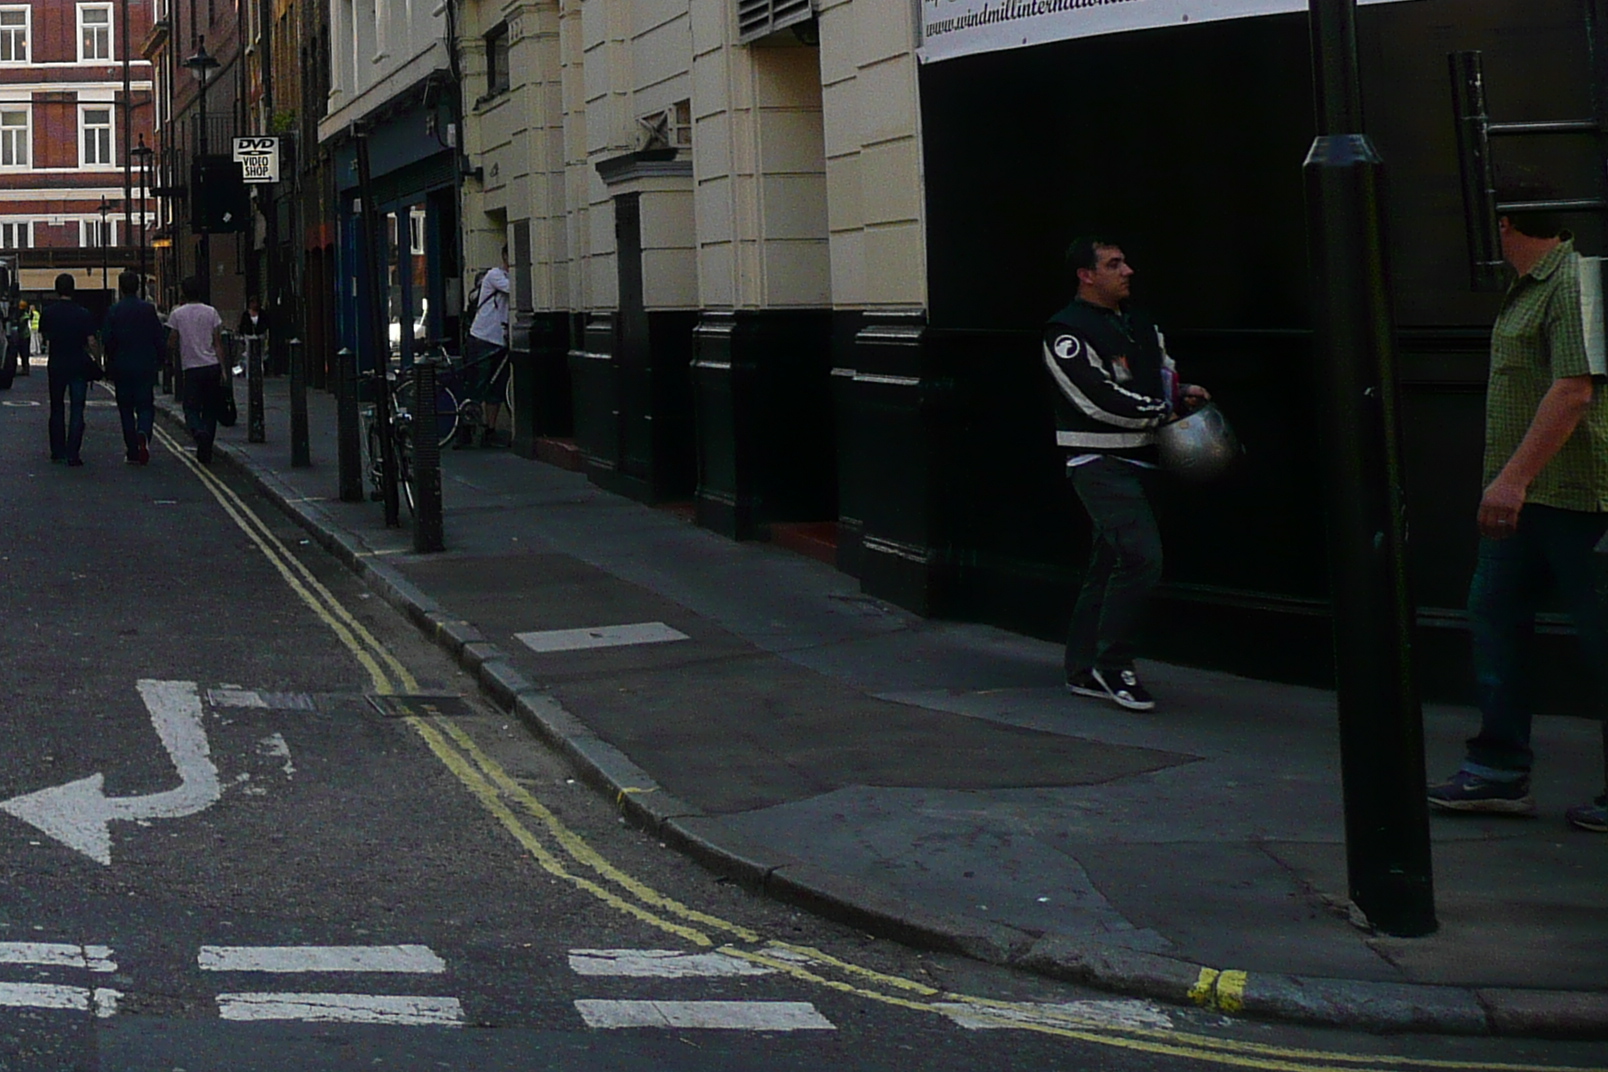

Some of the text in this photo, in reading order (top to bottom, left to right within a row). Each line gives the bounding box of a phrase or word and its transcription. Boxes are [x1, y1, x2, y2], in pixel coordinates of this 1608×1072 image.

[238, 139, 274, 150] DVD
[243, 156, 269, 166] VIDEO
[245, 167, 269, 177] SHOP
